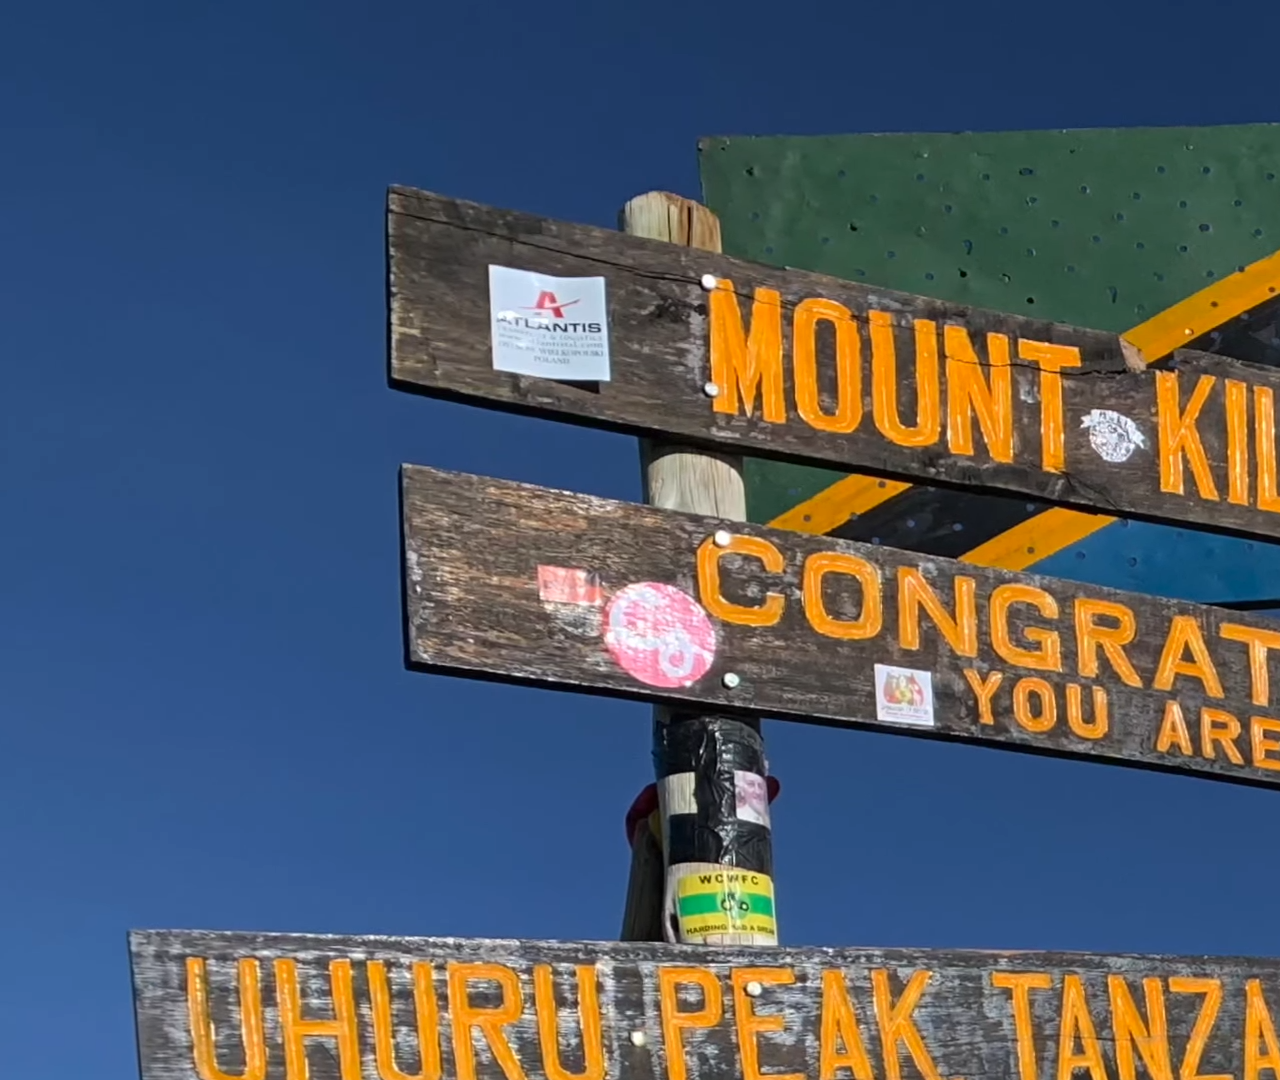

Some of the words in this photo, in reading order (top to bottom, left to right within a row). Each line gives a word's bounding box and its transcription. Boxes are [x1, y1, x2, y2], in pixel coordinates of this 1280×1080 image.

[496, 315, 602, 334] ATLANTIS
[709, 279, 1081, 472] MOUNT
[967, 671, 1108, 739] YOU
[686, 924, 729, 936] HARDING
